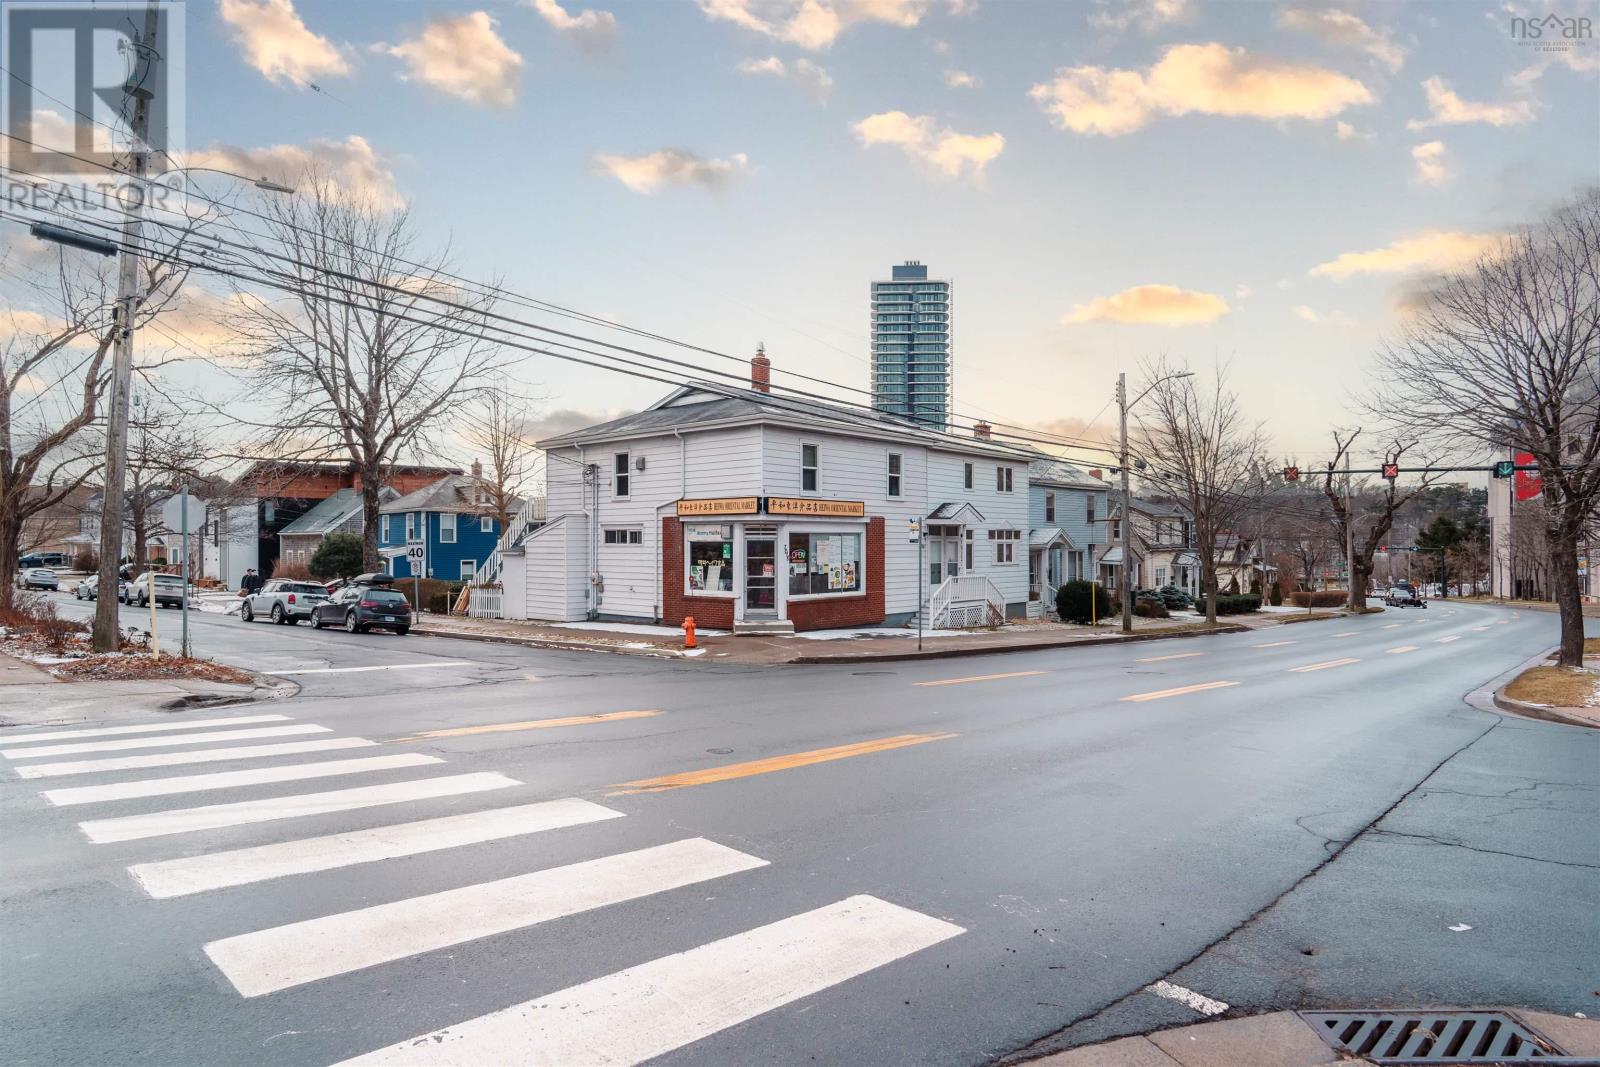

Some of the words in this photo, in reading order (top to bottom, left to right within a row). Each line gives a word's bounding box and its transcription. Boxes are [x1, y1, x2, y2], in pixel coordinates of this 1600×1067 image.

[831, 504, 848, 513] ORIENTAL
[848, 504, 862, 514] MARKET
[408, 547, 424, 558] 40
[791, 551, 806, 559] OPEN
